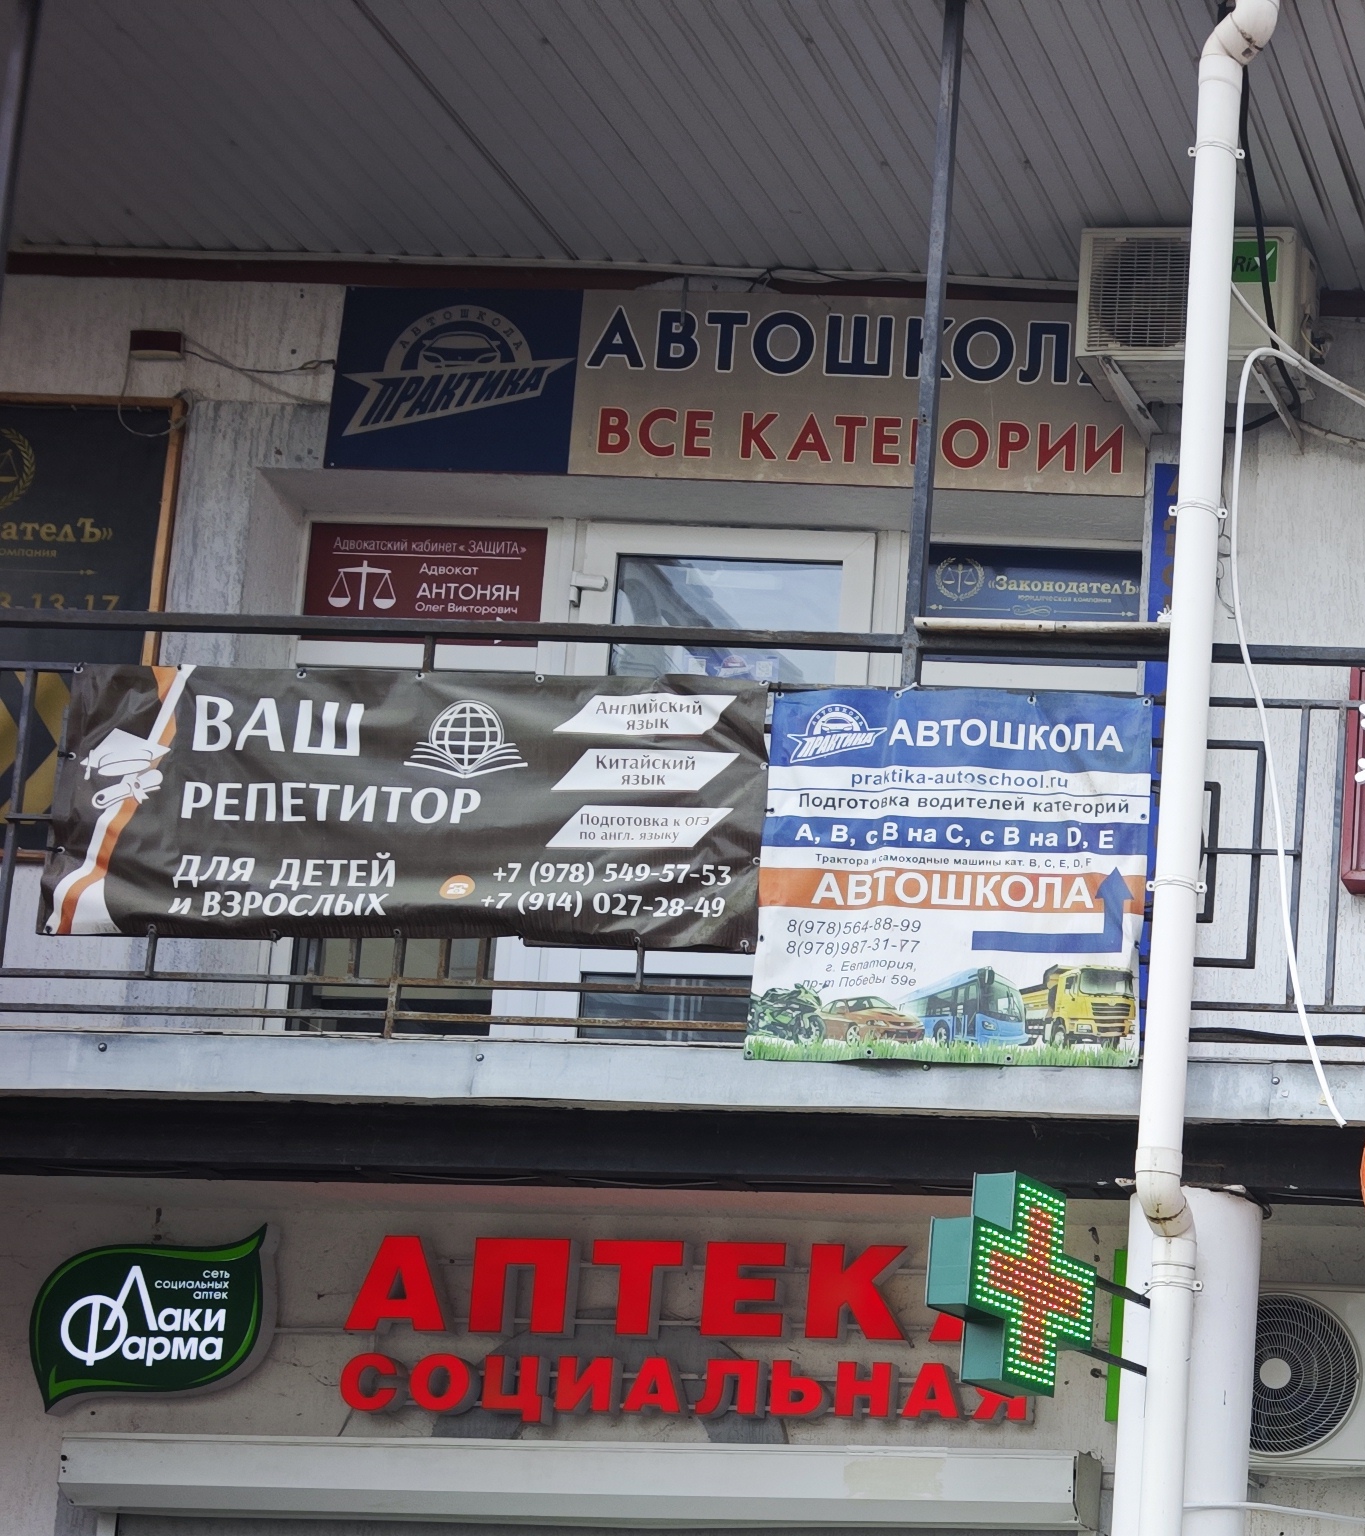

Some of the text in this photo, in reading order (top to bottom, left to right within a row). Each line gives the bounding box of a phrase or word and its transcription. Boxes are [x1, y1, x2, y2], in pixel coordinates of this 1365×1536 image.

[399, 308, 524, 350] АВТОШКОЛА
[585, 305, 1095, 386] АВТОШКОЛ
[358, 366, 551, 427] ПРАКТИКА
[596, 407, 715, 460] ВСЕ
[333, 536, 408, 552] Адвокатский
[411, 539, 457, 553] кабинет
[419, 563, 478, 576] Адвокат
[416, 583, 520, 602] АНТОНЯН
[415, 602, 518, 615] Олег Викторович
[596, 699, 703, 715] Английский
[192, 695, 365, 757] ВАШ
[627, 718, 670, 731] язык
[888, 718, 1124, 753] АВТОШКОЛА
[797, 732, 875, 758] ПРАКТИКА
[595, 754, 696, 771] Китайский
[621, 774, 666, 785] язык
[851, 767, 1069, 790] praktika-autoschool.ru
[181, 781, 482, 824] РЕПЕТИТОР
[799, 793, 1129, 817] Подготовка водителей категорий
[580, 813, 710, 827] Подготовка к ОГЭ
[579, 832, 680, 842] по англ. языку
[907, 827, 937, 842] на
[1029, 833, 1058, 847] на
[1067, 827, 1089, 849] D,
[172, 852, 396, 890] ДЛЯ ДЕТЕЙ
[816, 853, 1025, 867] Трактора самоходные машины кат.
[493, 861, 732, 886] +7 (978) 549-57-53
[811, 870, 1095, 909] АВТОШКОЛА
[201, 891, 390, 917] ВЗРОСЛЫХ
[481, 891, 726, 918] +7 (914) 027-28-49
[787, 917, 922, 938] 8(978)564-88-99
[841, 959, 917, 973] Евпатория,
[839, 974, 886, 988] Победы
[891, 974, 917, 987] 59е
[155, 1279, 230, 1290] социальных
[203, 1270, 230, 1279] сеть
[103, 1265, 227, 1332] Лаки
[193, 1291, 228, 1300] аптек
[343, 1235, 964, 1342] АПТЕК
[61, 1294, 224, 1367] Фарма
